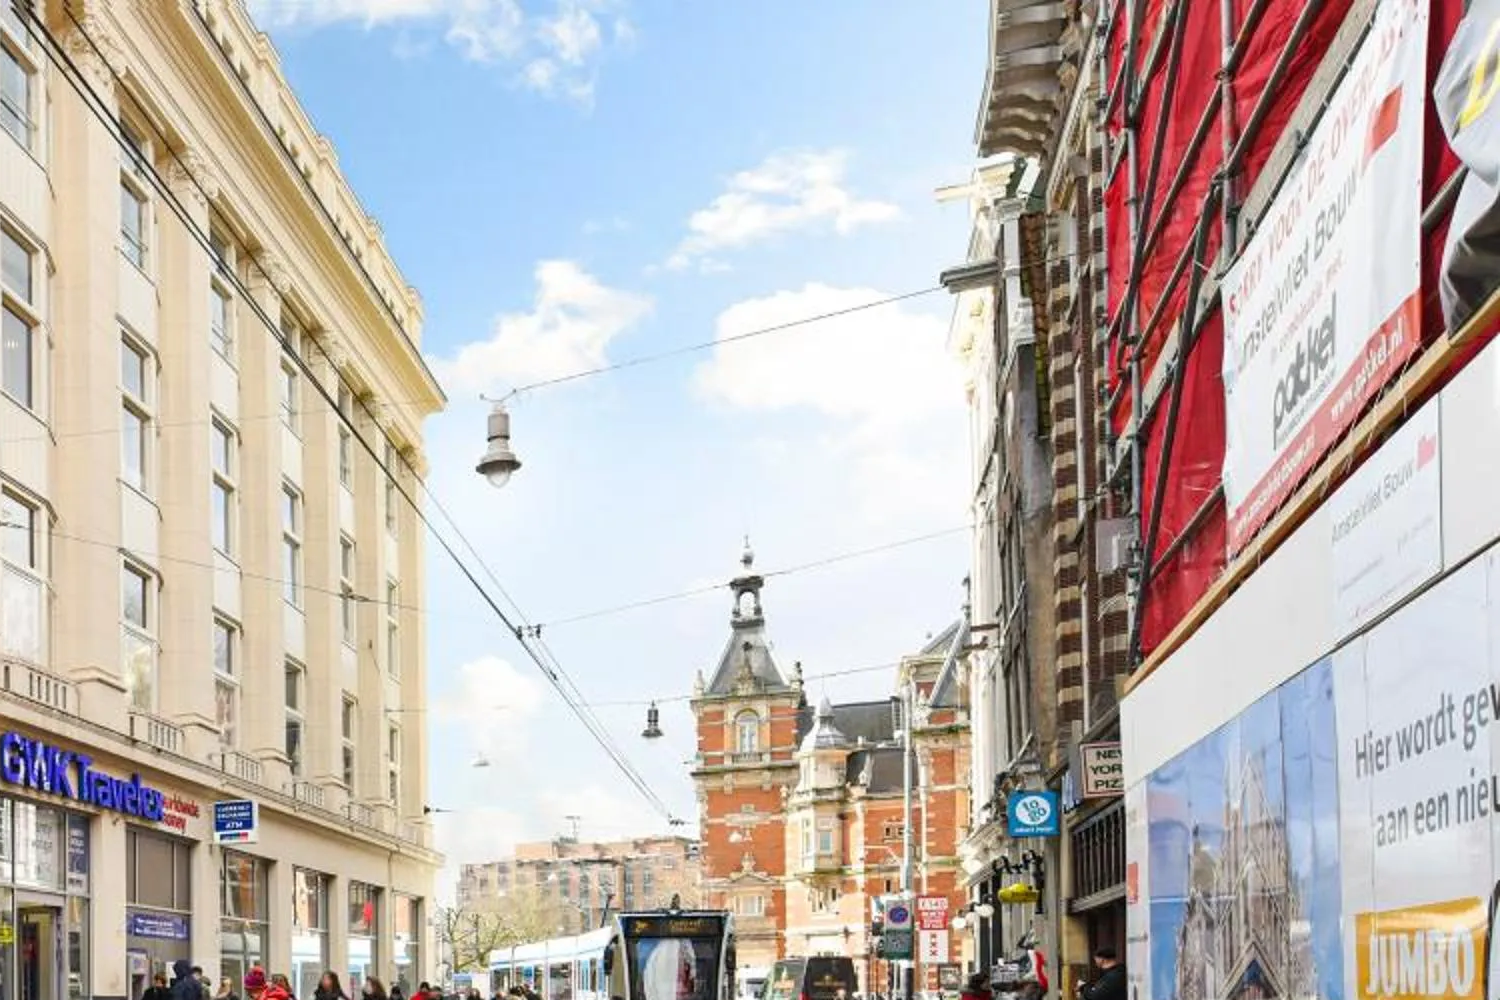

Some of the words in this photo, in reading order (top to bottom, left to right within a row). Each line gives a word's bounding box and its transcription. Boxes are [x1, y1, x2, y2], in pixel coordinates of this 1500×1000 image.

[1271, 290, 1336, 451] patkel
[1089, 763, 1122, 775] YOR
[1355, 730, 1392, 779] Hier
[1396, 692, 1457, 763] wordt
[76, 753, 165, 823] Travelex
[1376, 804, 1409, 848] aan
[1413, 790, 1450, 836] een
[225, 821, 243, 829] ATM
[1366, 926, 1475, 997] JUMBO
